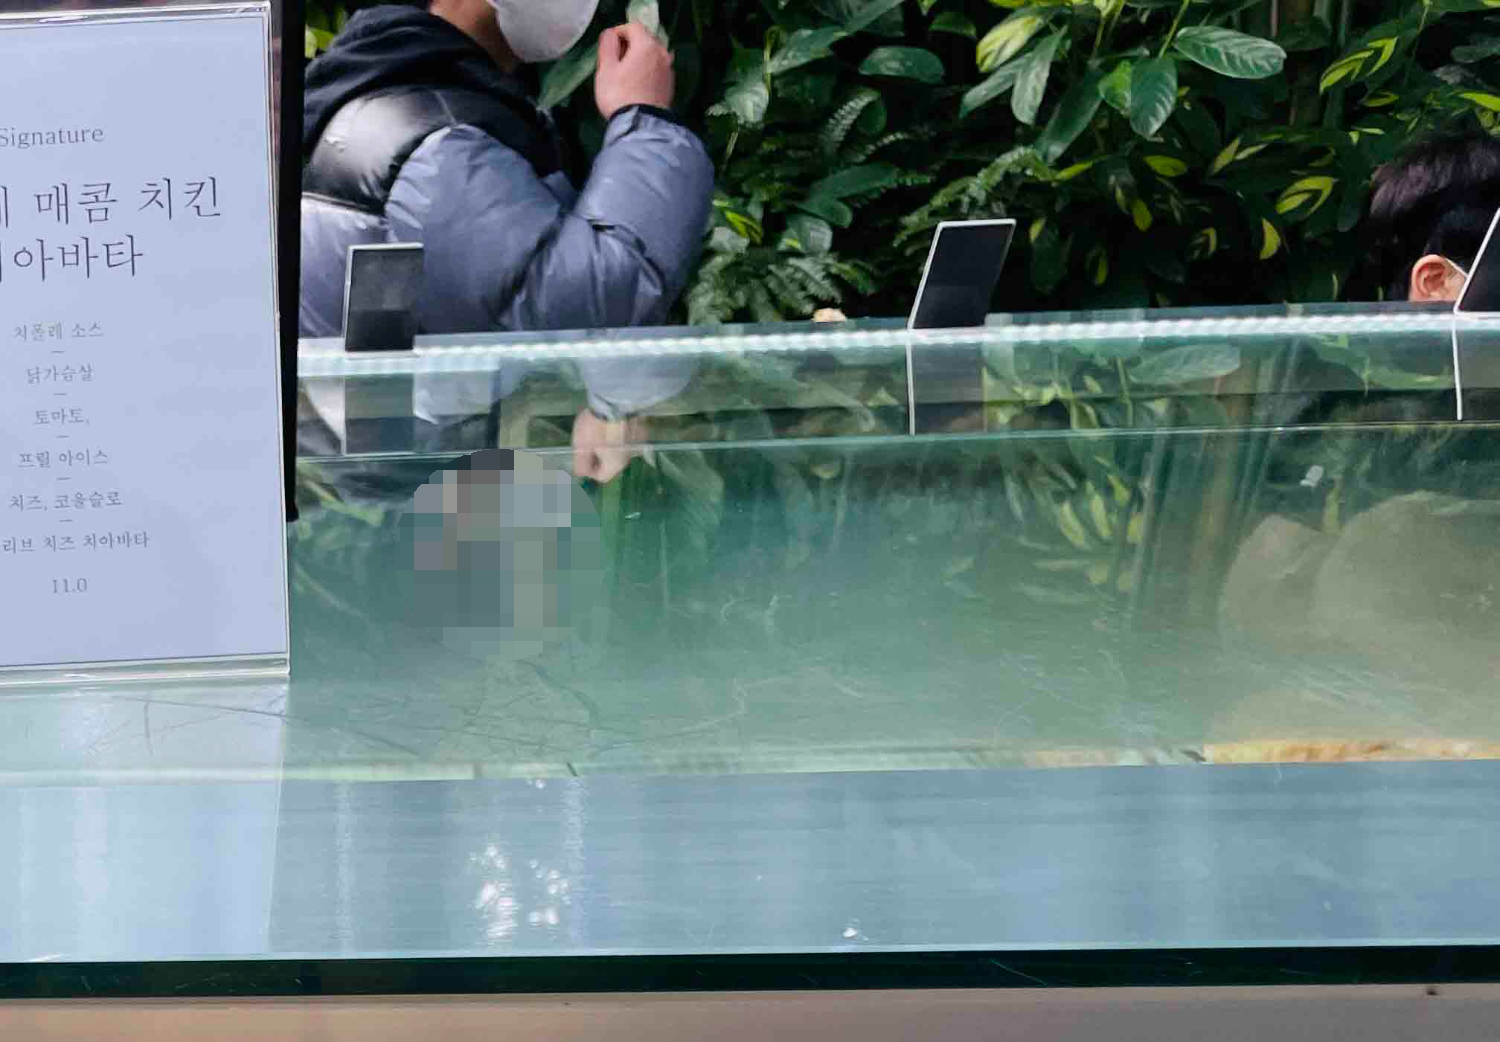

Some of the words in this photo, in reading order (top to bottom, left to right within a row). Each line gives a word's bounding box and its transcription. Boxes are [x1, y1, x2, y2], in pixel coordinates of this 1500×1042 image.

[33, 182, 118, 225] 매콤
[137, 176, 222, 221] 치킨
[12, 321, 63, 342] 치폴레
[71, 321, 105, 338] 소스
[26, 363, 94, 385] 닭가슴살
[33, 407, 90, 426] 토마토,
[17, 450, 51, 469] 프릴
[58, 448, 108, 466] 아이스
[9, 493, 48, 512] 치즈,
[53, 490, 123, 510] 코울슬로
[43, 534, 76, 552] 치즈
[82, 530, 150, 551] 치아바타
[52, 577, 88, 594] 11.0
